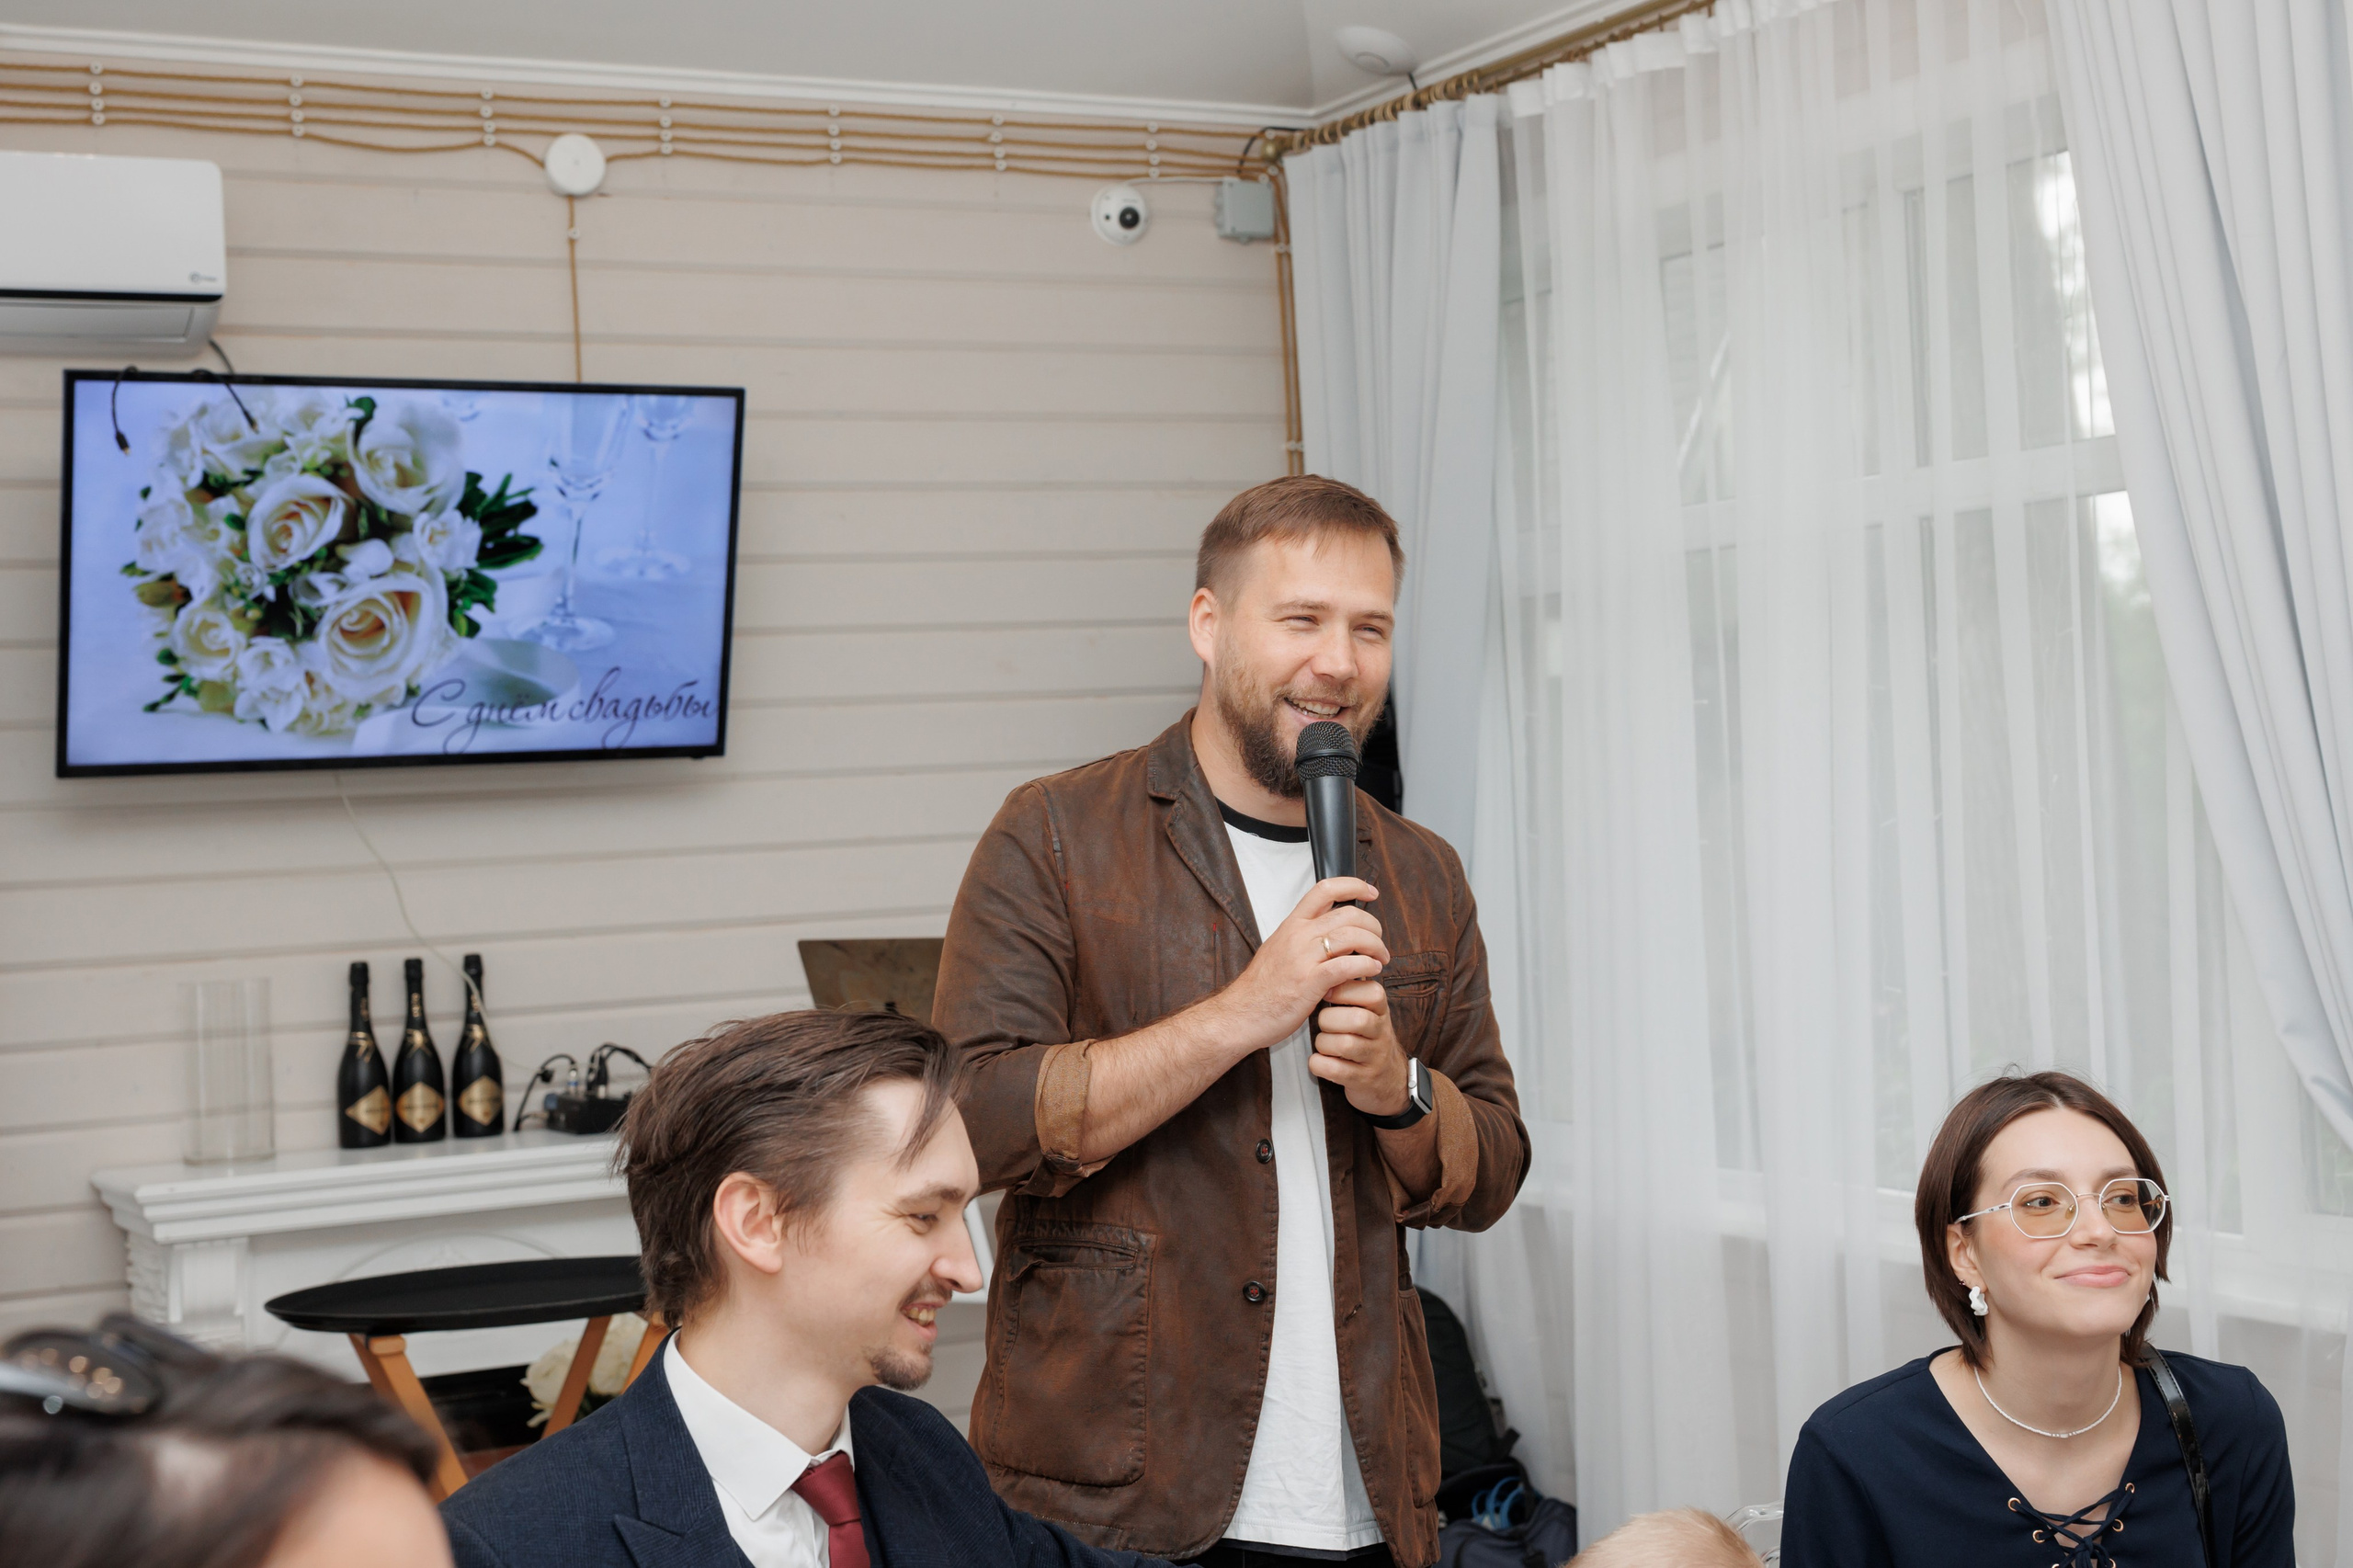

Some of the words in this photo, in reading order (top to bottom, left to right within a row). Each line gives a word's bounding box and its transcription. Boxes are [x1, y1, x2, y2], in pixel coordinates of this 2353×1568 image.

[412, 678, 466, 727] С
[442, 693, 566, 754] днём
[569, 666, 717, 748] свадьбы
